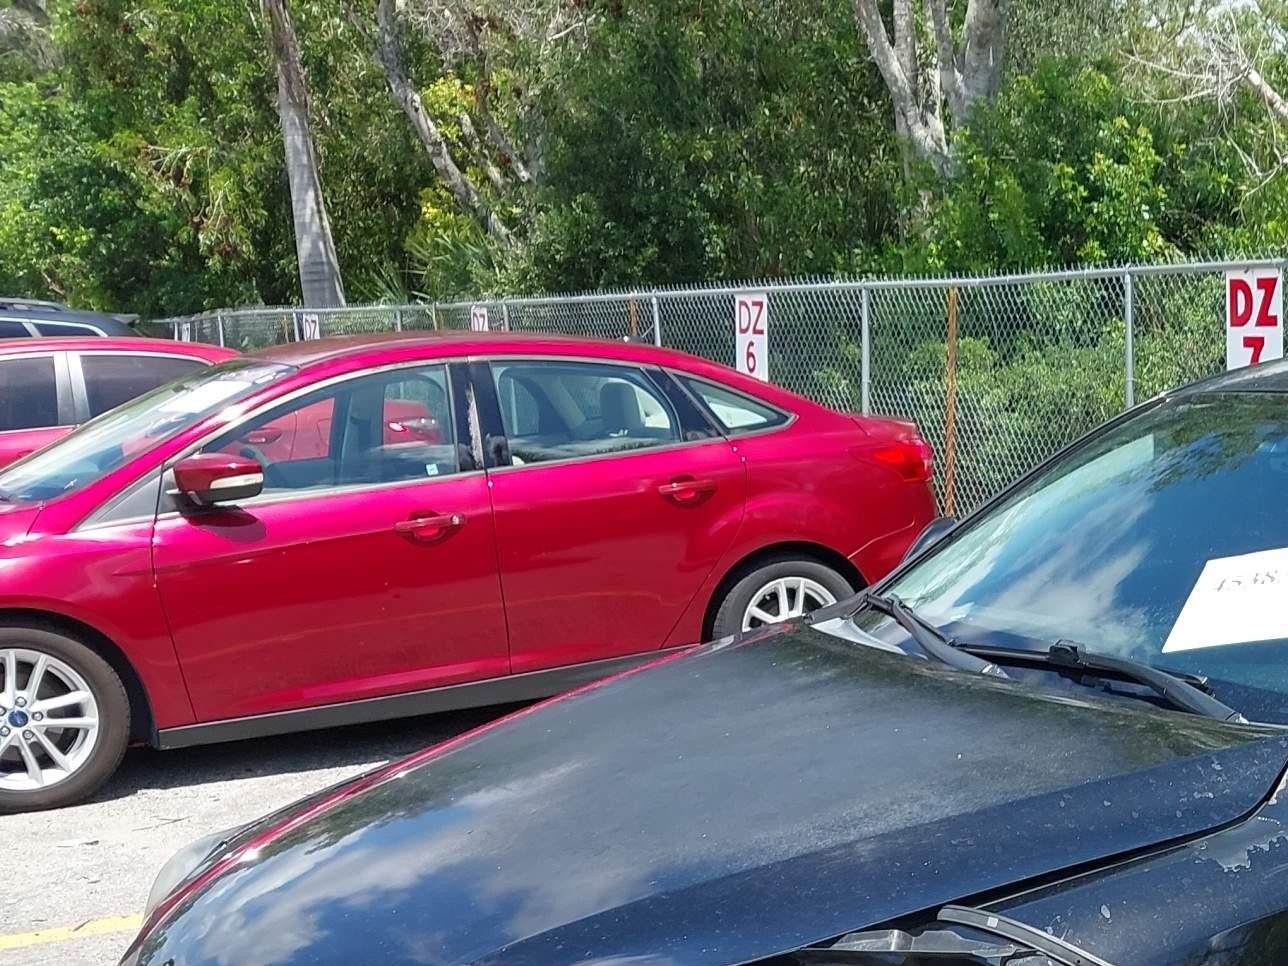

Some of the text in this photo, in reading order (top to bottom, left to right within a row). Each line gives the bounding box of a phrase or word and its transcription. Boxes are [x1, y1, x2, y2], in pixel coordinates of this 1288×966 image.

[739, 300, 765, 335] DZ
[1229, 277, 1278, 327] DZ
[746, 340, 756, 373] 6
[1243, 336, 1265, 365] 7
